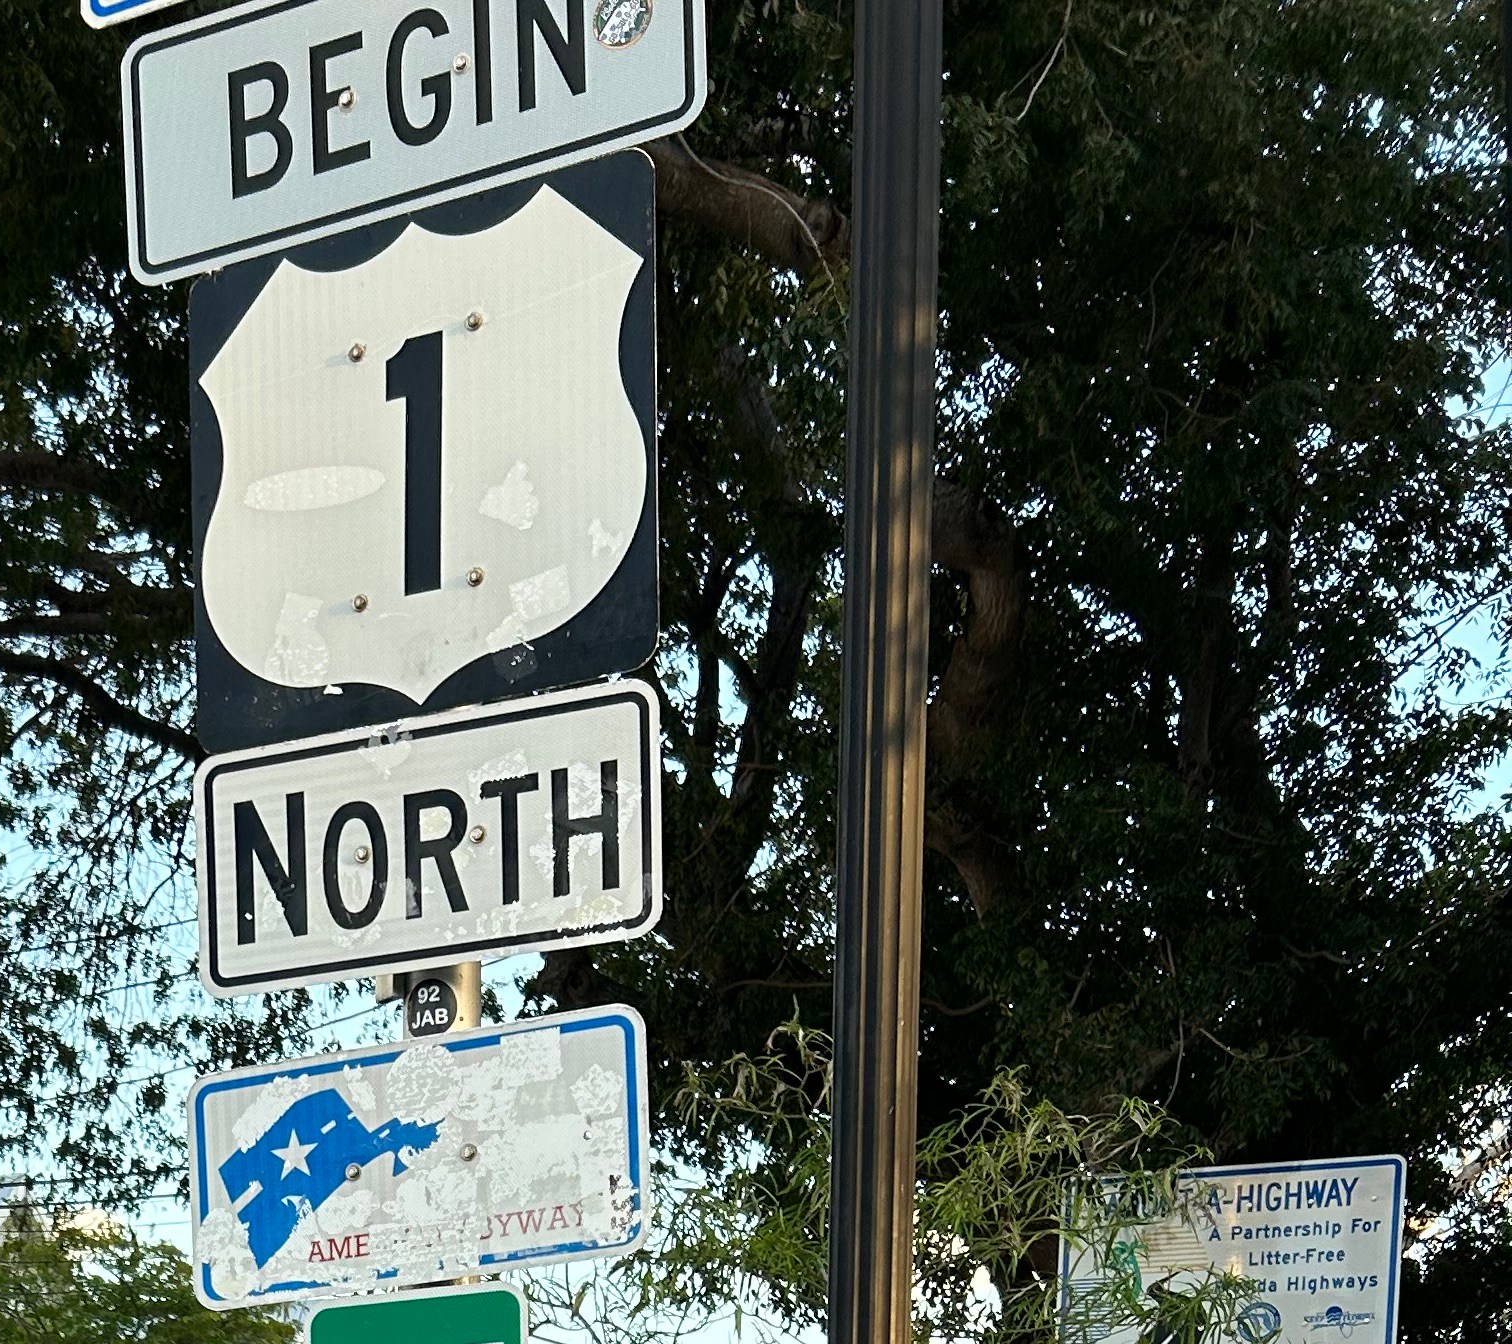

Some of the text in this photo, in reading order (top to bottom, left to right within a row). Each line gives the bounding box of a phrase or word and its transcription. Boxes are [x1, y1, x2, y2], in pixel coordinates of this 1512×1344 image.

[227, 0, 587, 199] BEGIN
[385, 330, 444, 596] 1
[233, 759, 621, 946] NORTH
[417, 985, 441, 1005] 92
[411, 1007, 449, 1029] JAB
[1208, 1217, 1382, 1242] A Partnership For
[1248, 1248, 1346, 1266] Litter-Free
[1287, 1274, 1378, 1295] Highways
